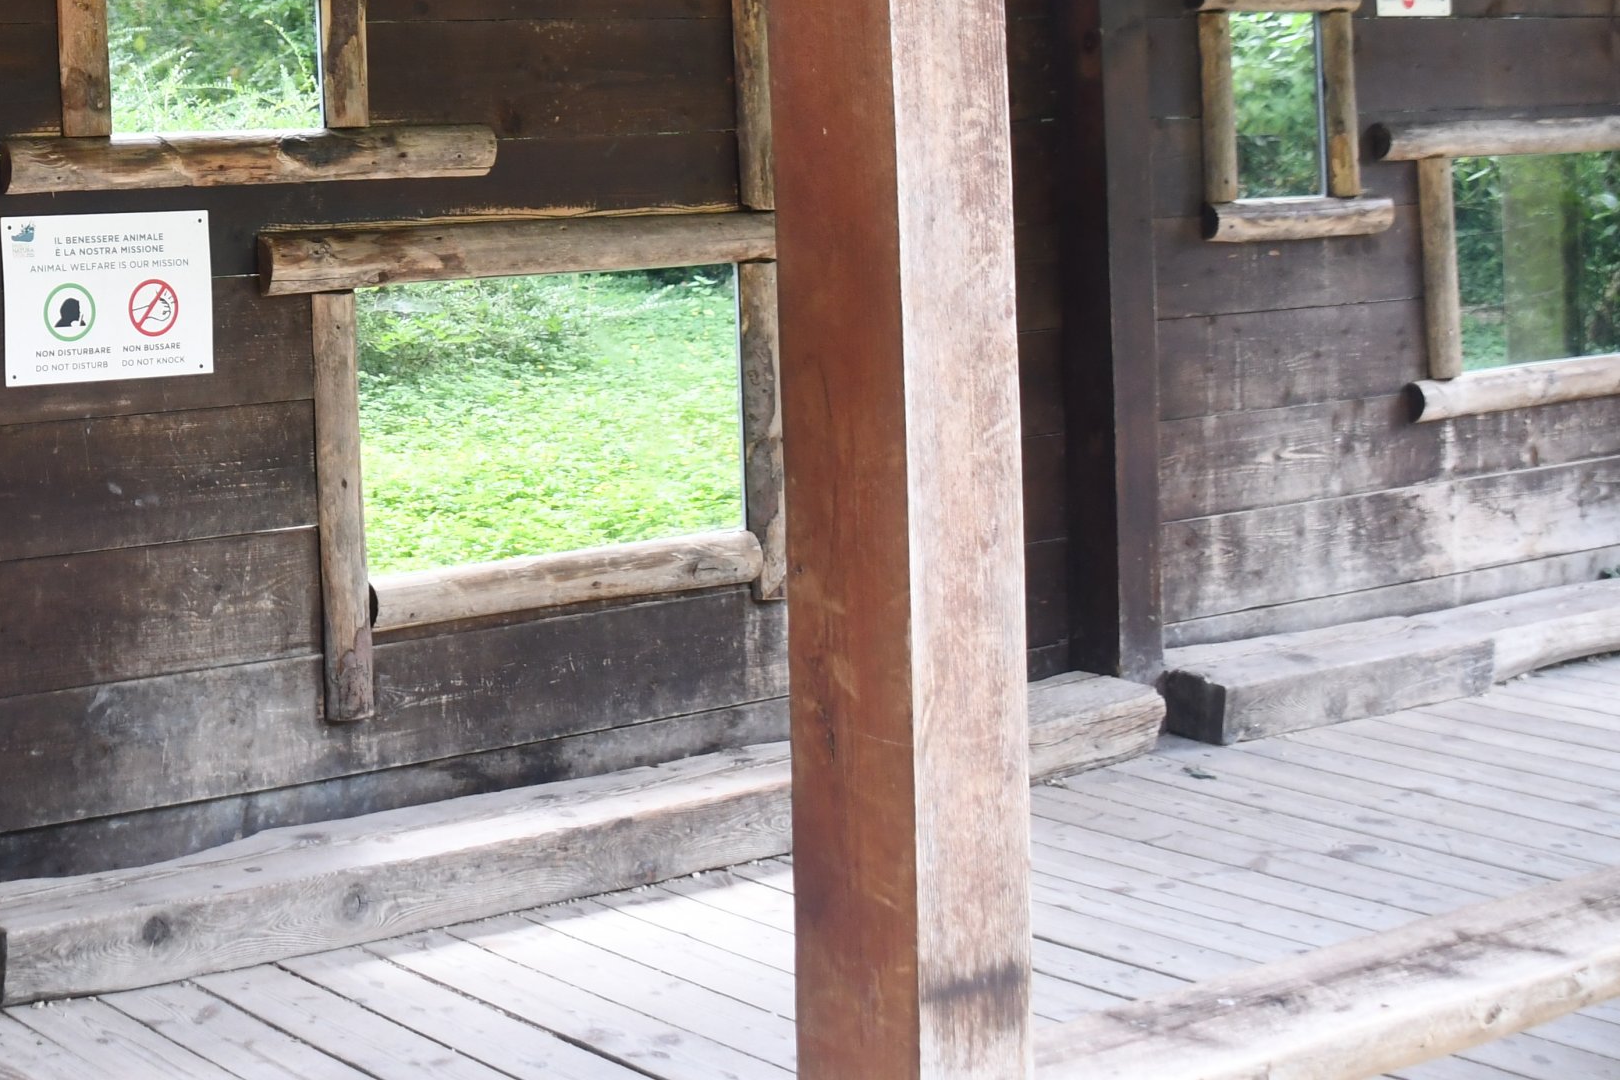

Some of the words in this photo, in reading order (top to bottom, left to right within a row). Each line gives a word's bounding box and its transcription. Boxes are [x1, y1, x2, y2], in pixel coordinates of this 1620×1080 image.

[54, 237, 62, 245] IL
[65, 235, 120, 244] BENESSERE
[123, 233, 164, 242] ANIMALE
[64, 247, 76, 257] LA
[79, 246, 118, 256] NOSTRA
[121, 245, 164, 254] MISSIONE
[30, 263, 67, 273] ANIMAL
[70, 262, 116, 271] WELFARE
[119, 261, 127, 269] IS
[130, 260, 149, 269] OUR
[152, 259, 189, 268] MISSION
[36, 350, 55, 358] NON
[58, 347, 111, 357] DISTURBARE
[123, 345, 141, 353] NON
[144, 343, 181, 352] BUSSARE
[36, 364, 49, 372] DO
[51, 363, 70, 371] NOT
[72, 361, 108, 370] DISTURB
[122, 359, 135, 367] DO
[137, 358, 154, 366] NOT
[156, 356, 185, 365] KNOCK
